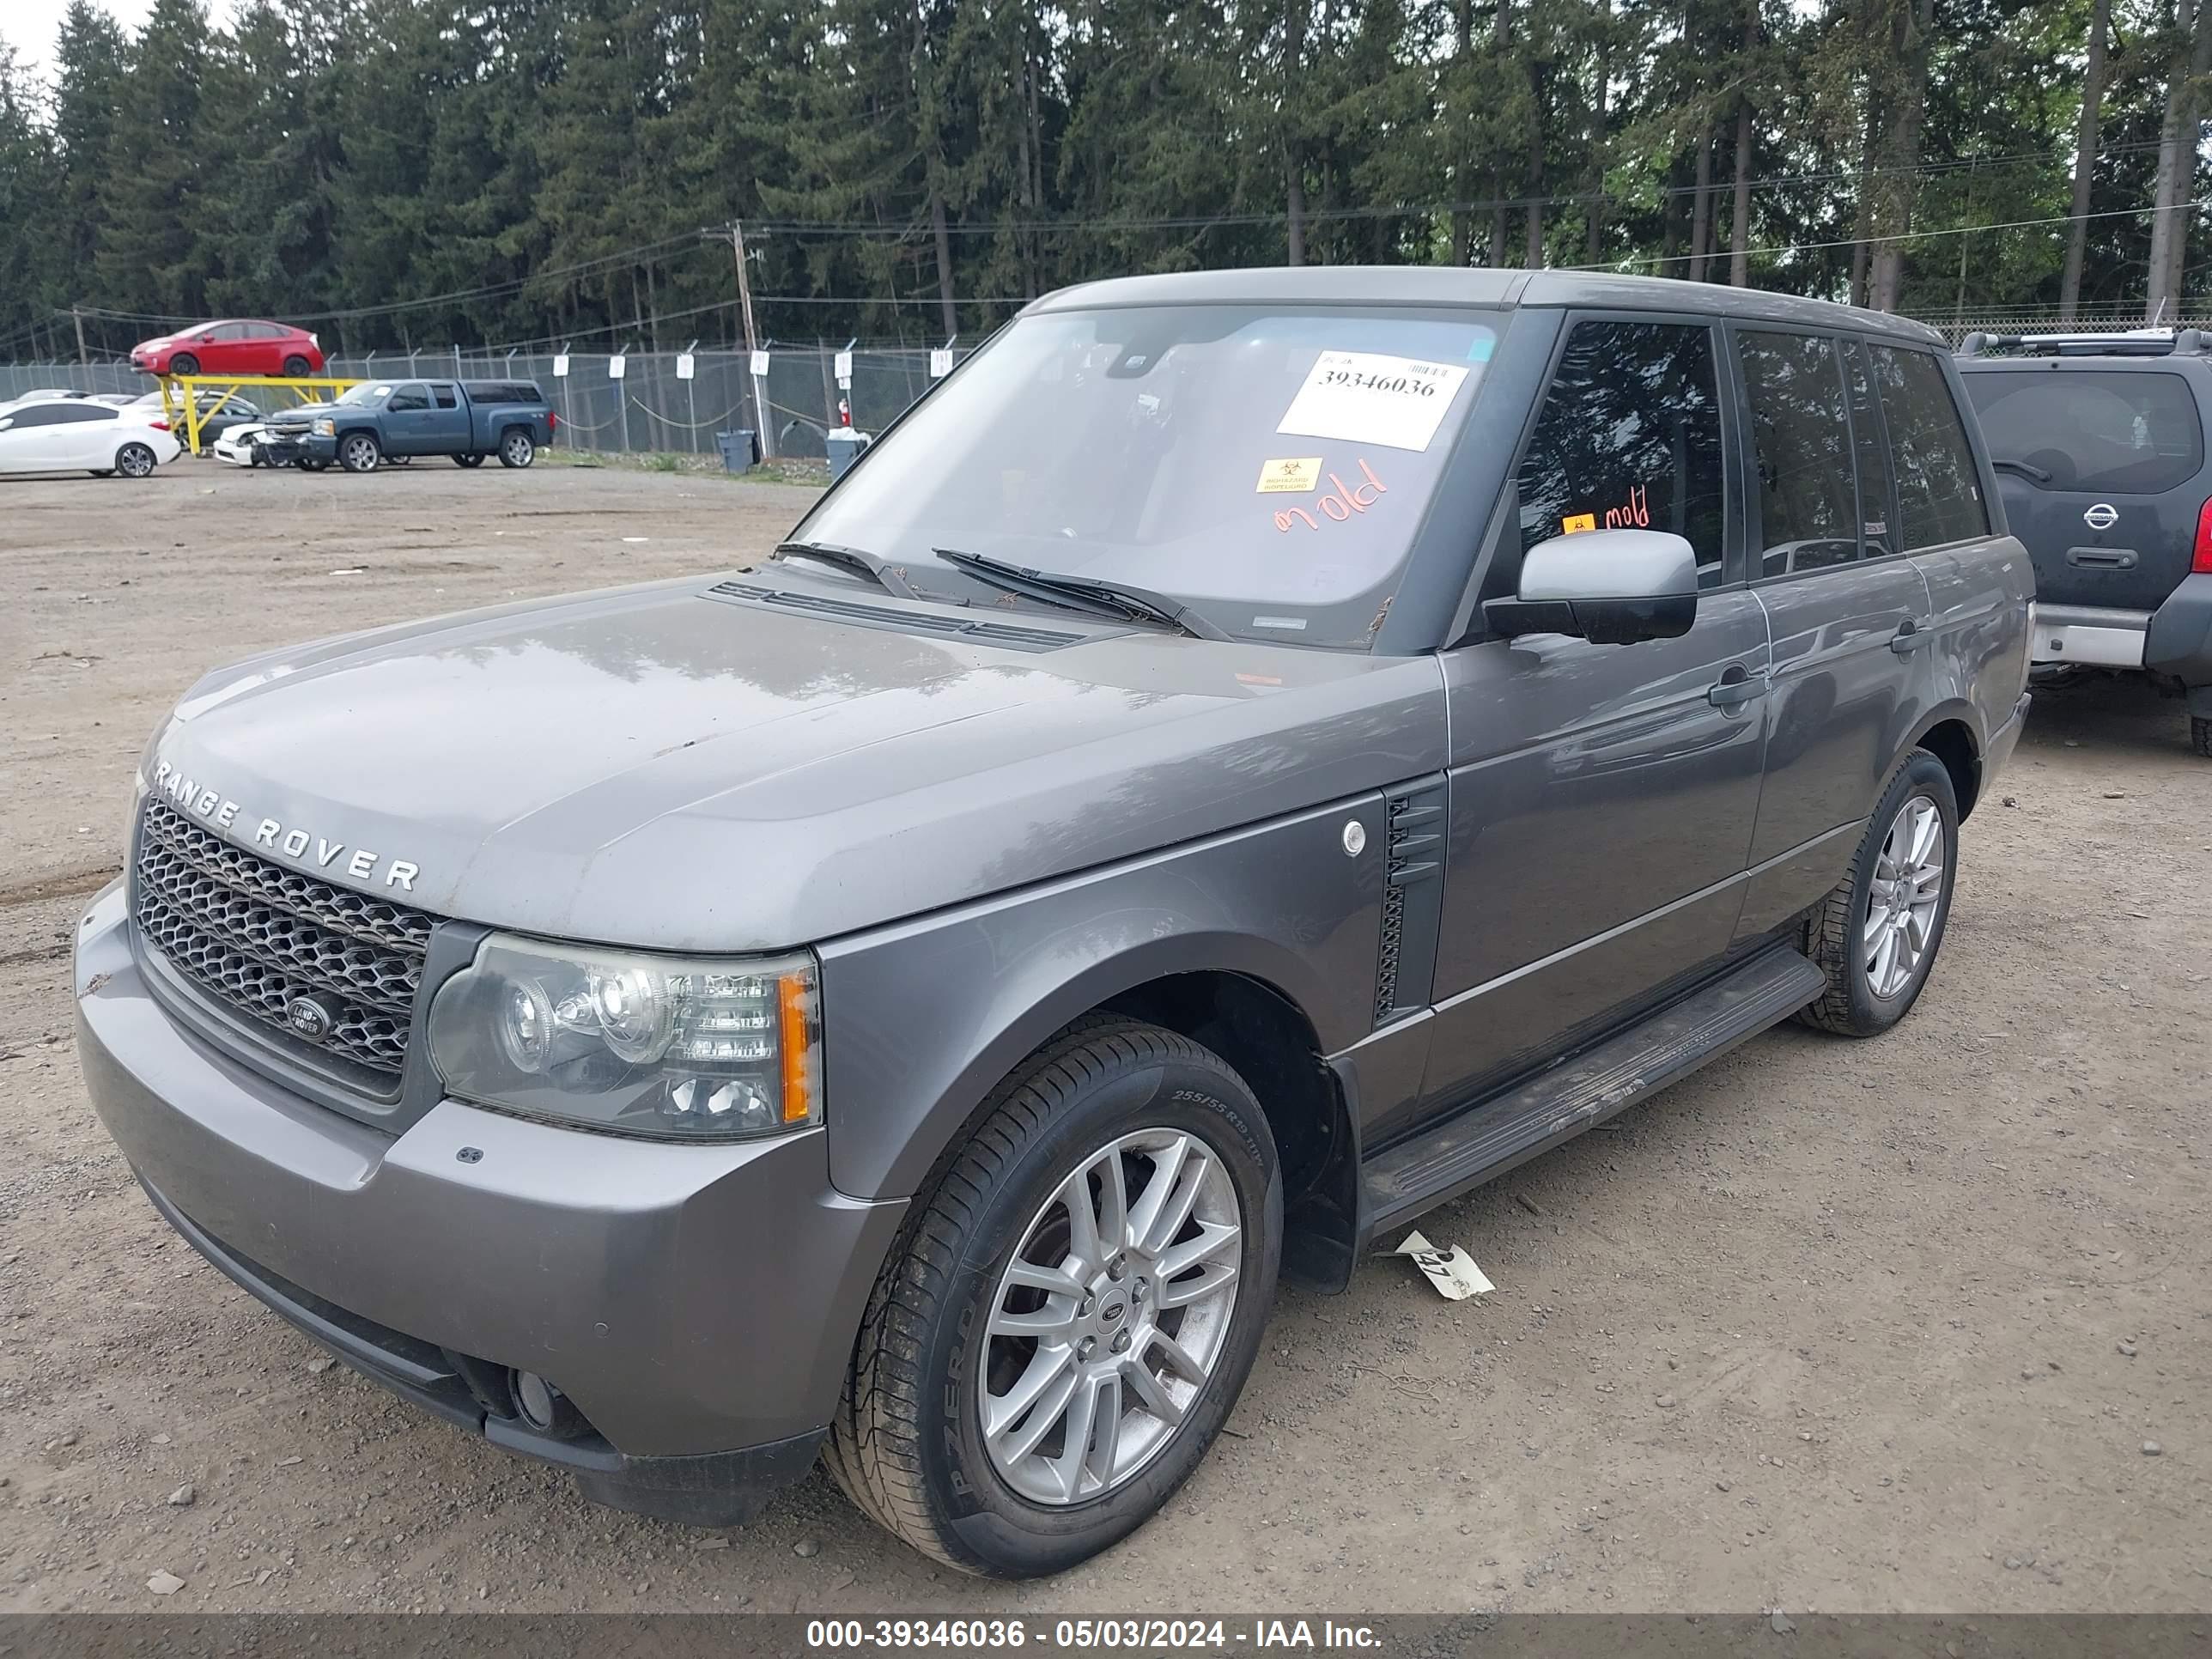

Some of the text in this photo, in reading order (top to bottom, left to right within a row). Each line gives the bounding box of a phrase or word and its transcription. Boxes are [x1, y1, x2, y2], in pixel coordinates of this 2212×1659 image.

[1318, 370, 1437, 397] 39346036
[1274, 459, 1388, 532] mold
[1605, 483, 1649, 530] mold
[155, 761, 420, 891] RANGE ROVER
[294, 1006, 313, 1021] LAND
[295, 1017, 318, 1034] ROVER
[1171, 1090, 1228, 1114] 255/55
